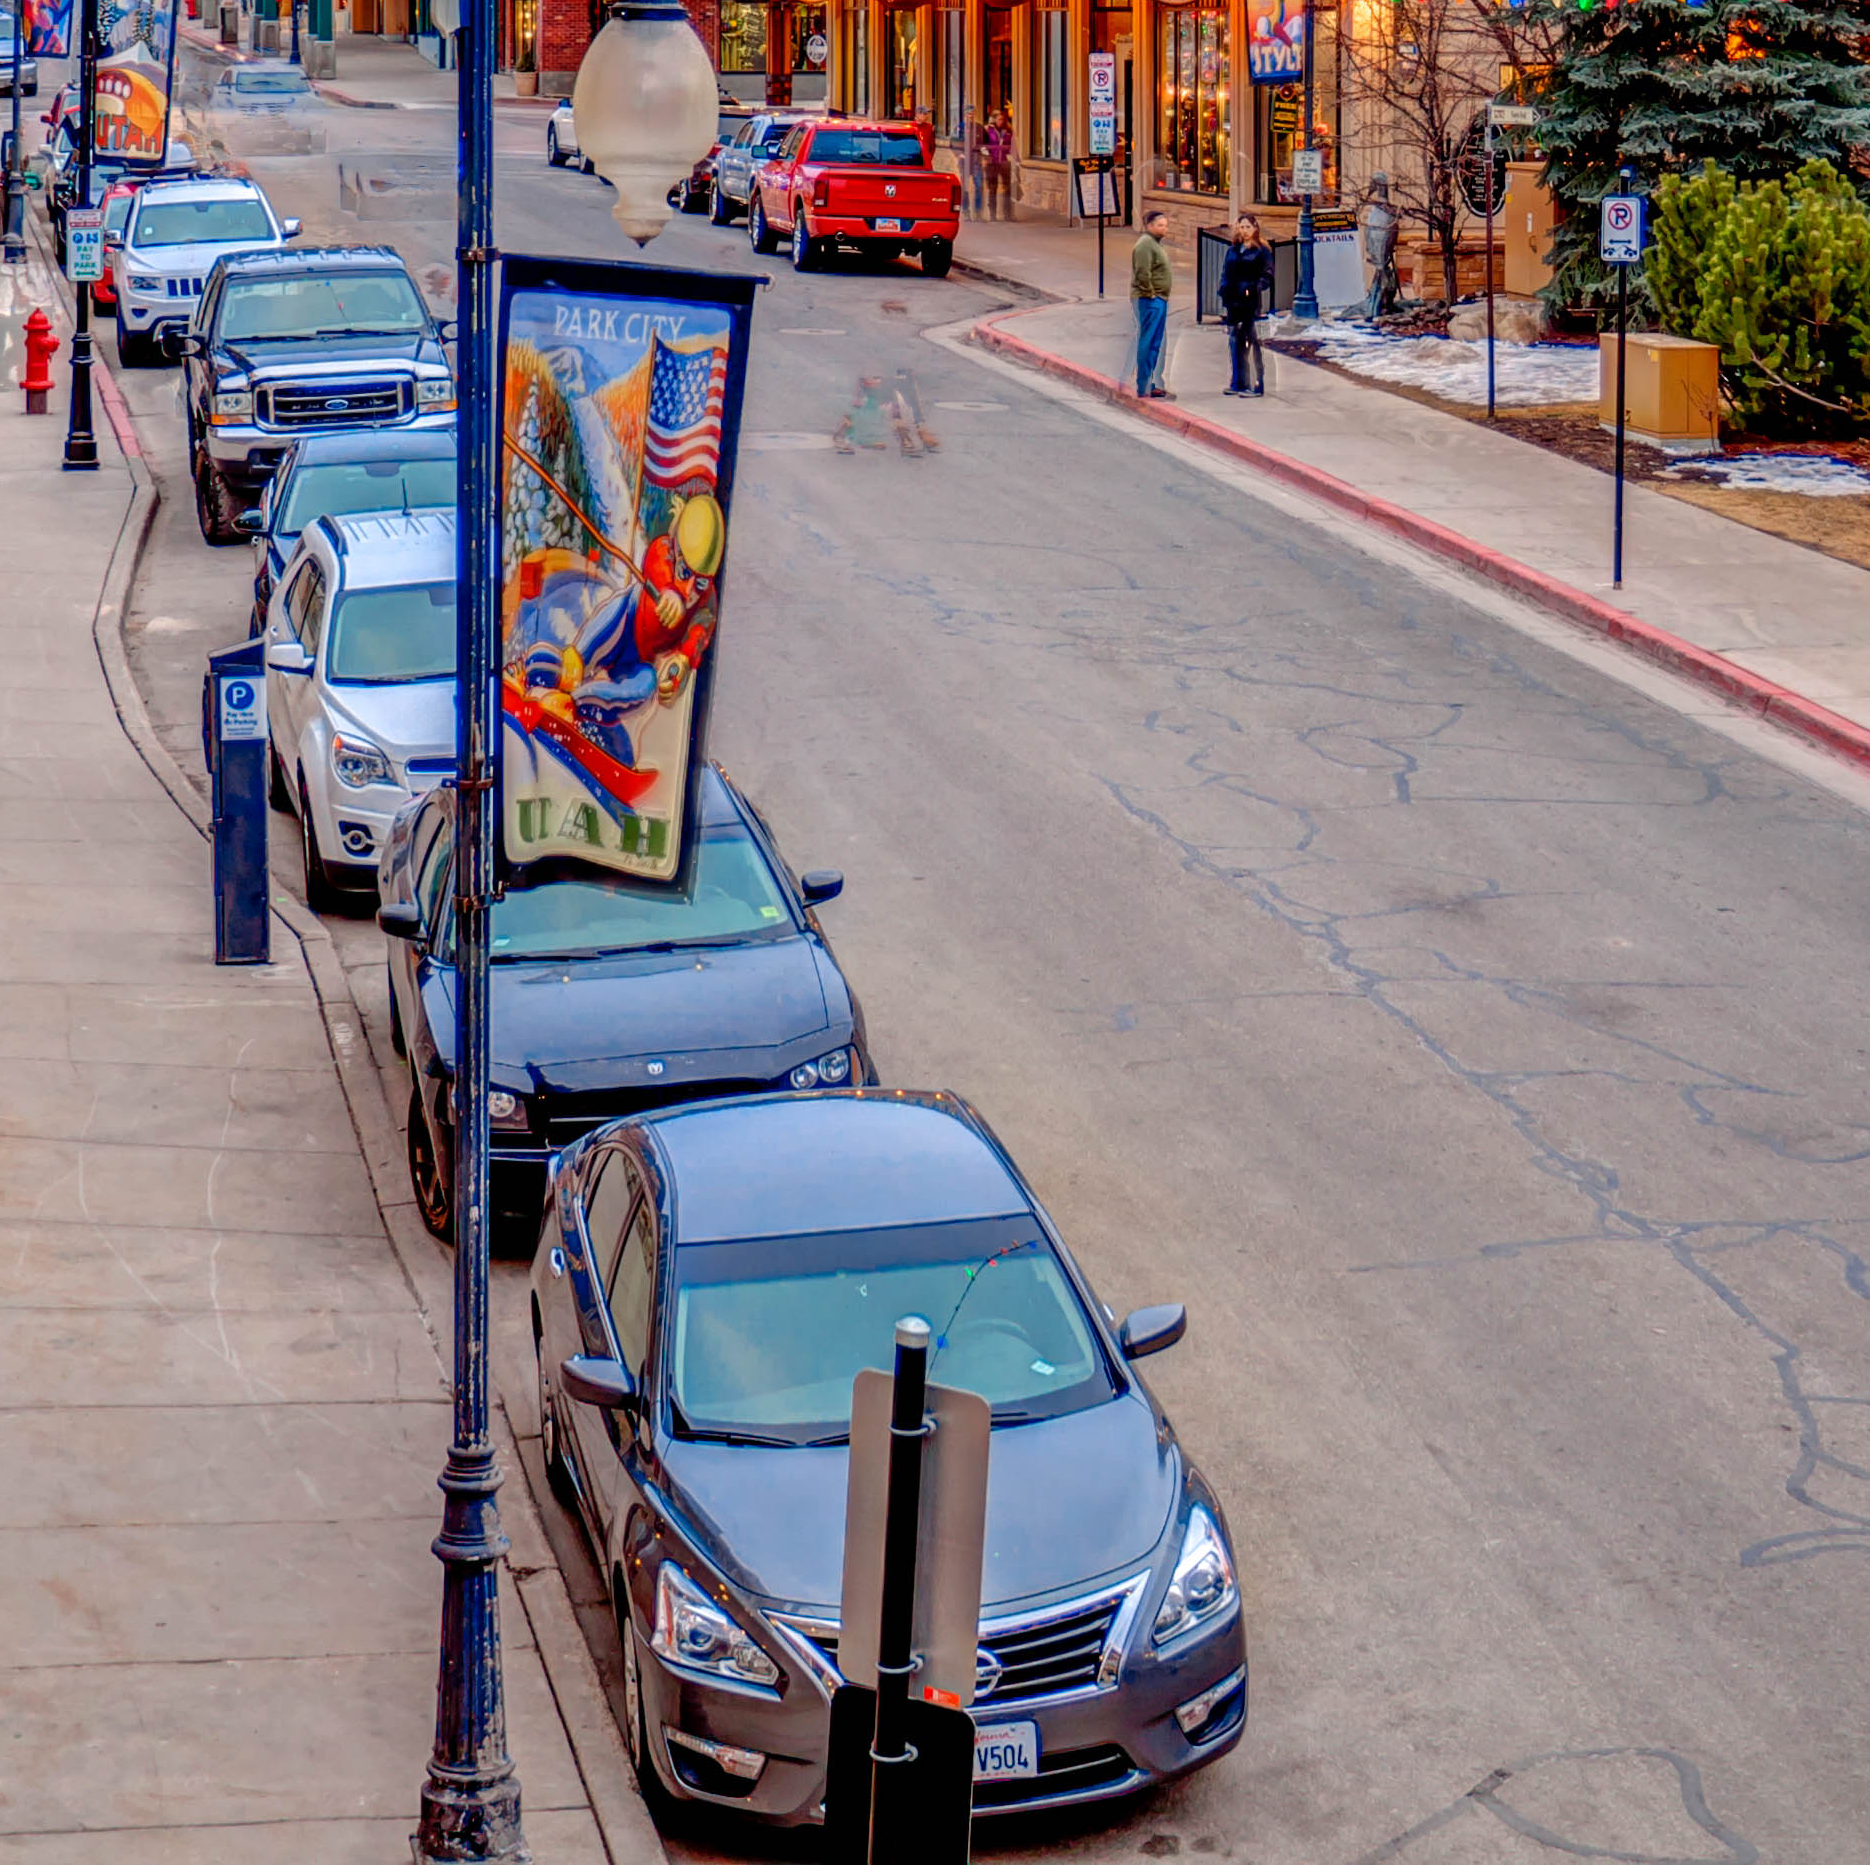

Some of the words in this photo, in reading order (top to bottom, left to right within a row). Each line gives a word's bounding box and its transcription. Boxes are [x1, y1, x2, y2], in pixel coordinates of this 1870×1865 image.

[96, 114, 162, 153] UTAH
[1314, 234, 1354, 242] OCKTAILS
[554, 304, 619, 341] PARK
[625, 313, 686, 345] CITY
[977, 1744, 1028, 1772] V504
